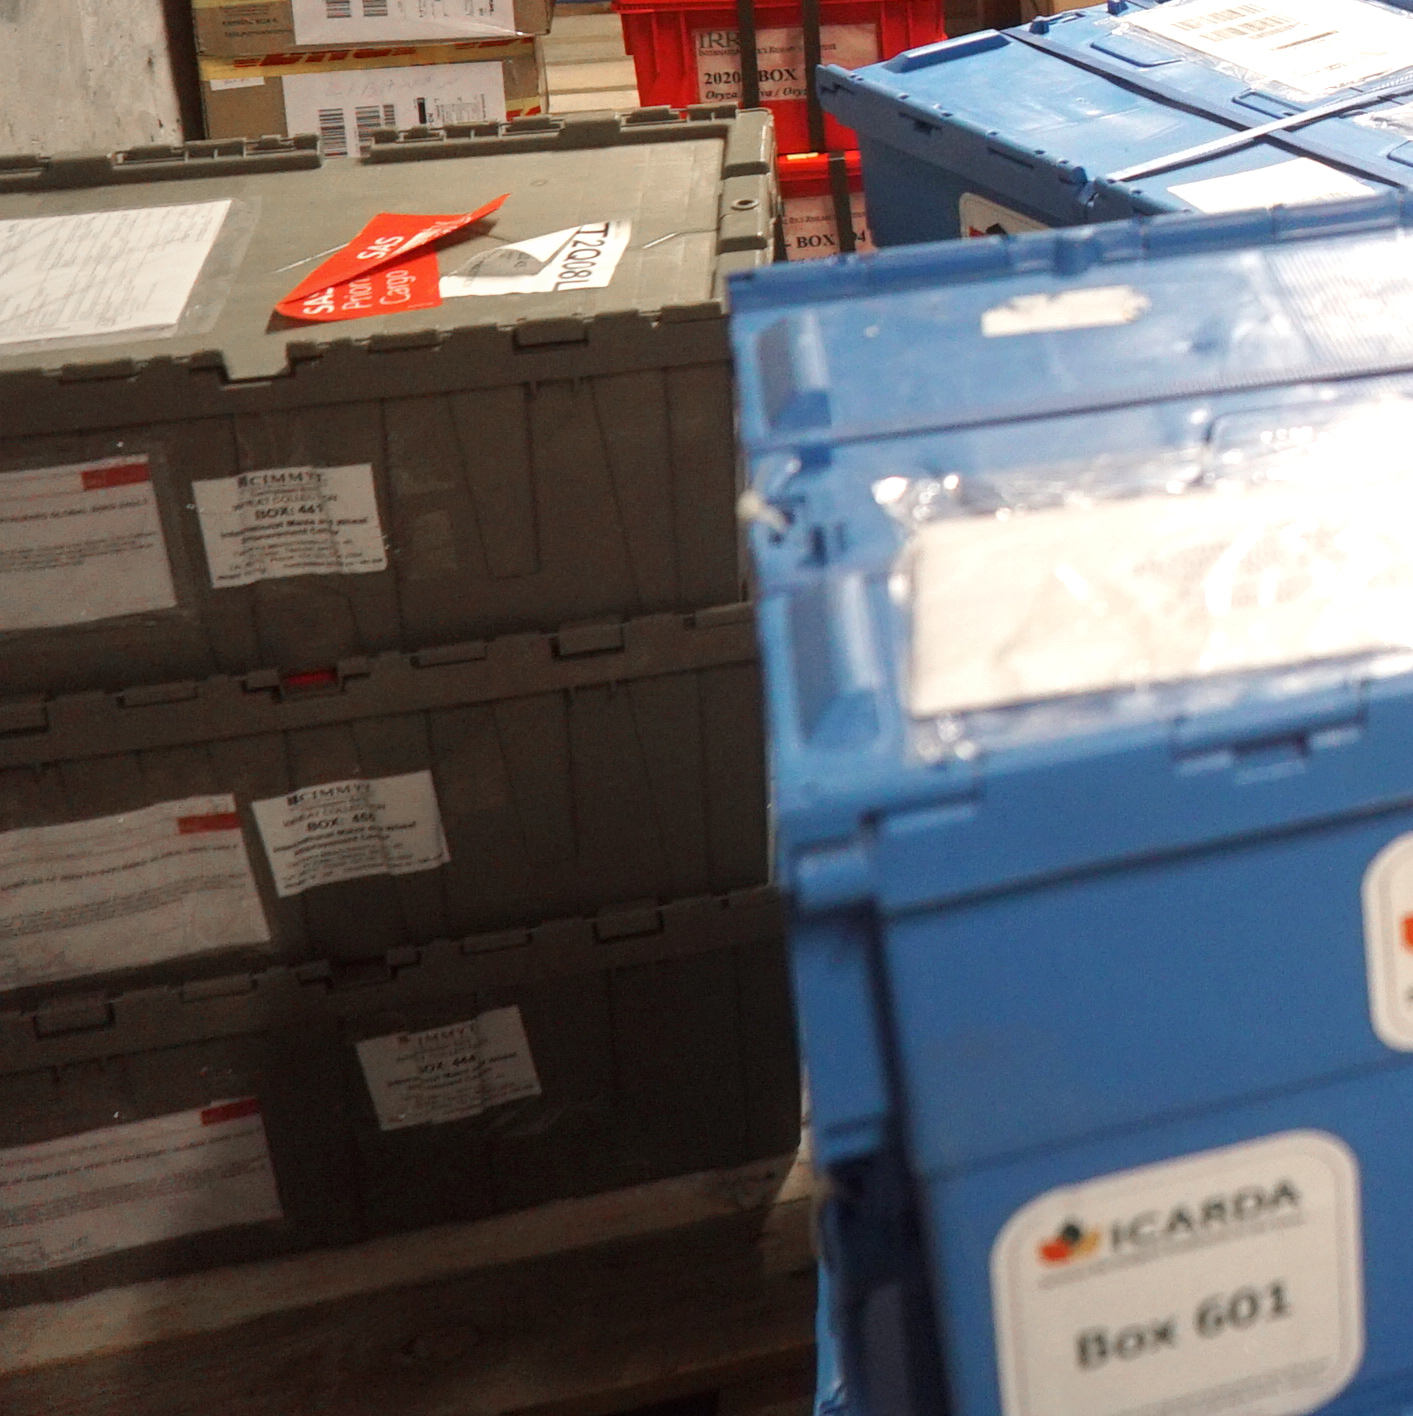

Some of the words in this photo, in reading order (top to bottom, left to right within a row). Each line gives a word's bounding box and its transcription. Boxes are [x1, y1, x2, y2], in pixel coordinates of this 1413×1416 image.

[699, 31, 741, 49] IRR
[704, 71, 741, 85] 2020
[759, 68, 798, 82] BOX
[705, 88, 739, 100] Oryza
[357, 235, 404, 260] SAS
[796, 234, 835, 249] BOX
[380, 270, 417, 306] Cargo
[1111, 1179, 1301, 1250] ICARDA
[1075, 1315, 1177, 1370] Box
[1193, 1278, 1291, 1337] 601
